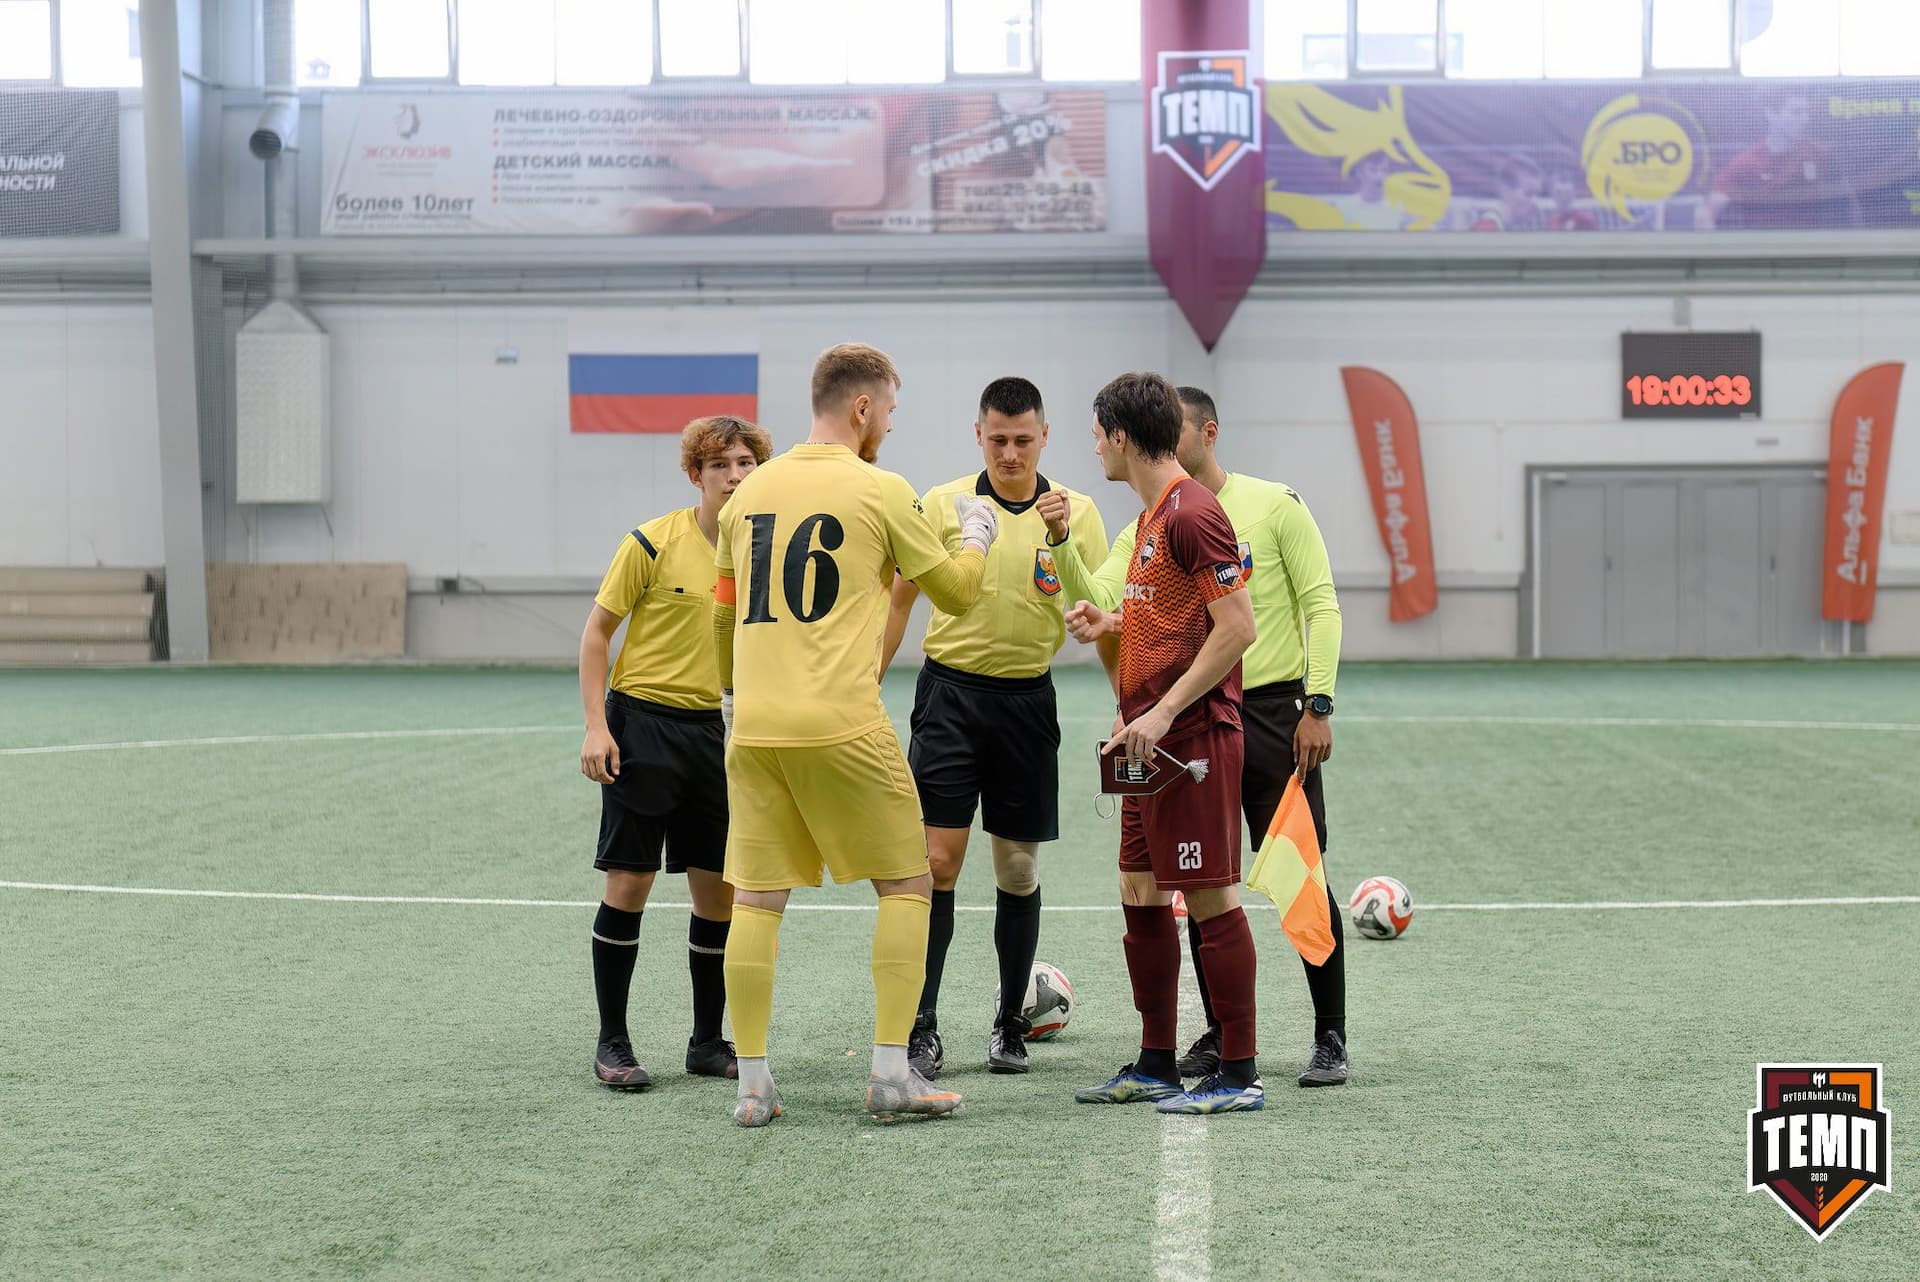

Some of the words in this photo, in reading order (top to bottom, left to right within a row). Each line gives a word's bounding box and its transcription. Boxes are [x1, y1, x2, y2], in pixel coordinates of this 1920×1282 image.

[1162, 89, 1250, 138] ТЕМП
[494, 153, 581, 170] ДЕТСКИЙ
[336, 194, 403, 212] более
[743, 513, 845, 624] 16
[1178, 842, 1202, 870] 23
